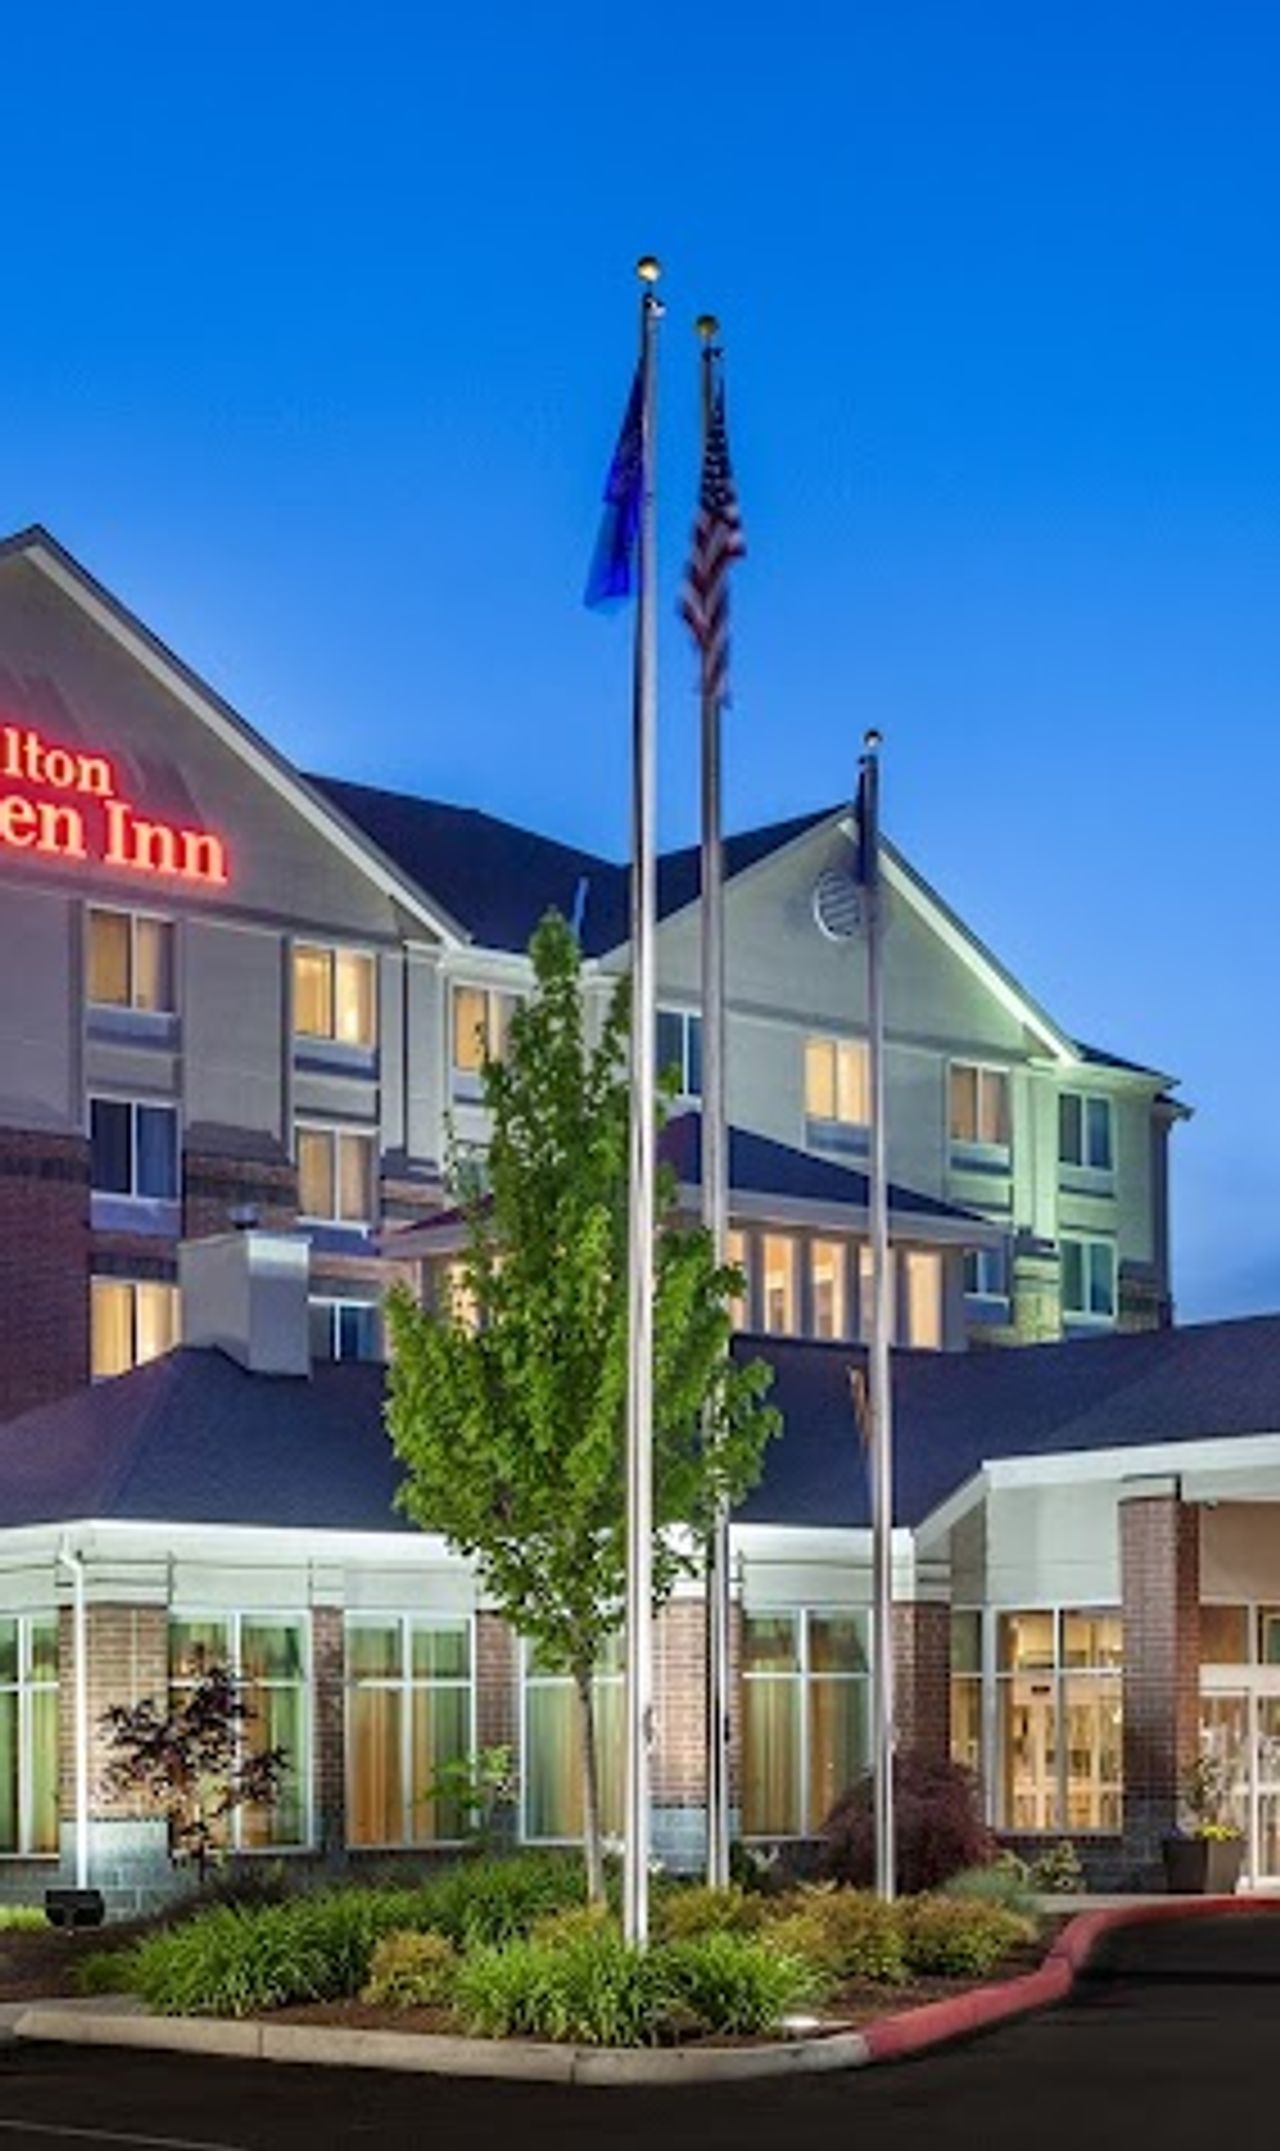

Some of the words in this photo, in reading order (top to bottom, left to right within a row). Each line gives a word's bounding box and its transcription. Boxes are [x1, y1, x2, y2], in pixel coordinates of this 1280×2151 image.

[3, 727, 114, 796] lton
[0, 795, 87, 859] en
[104, 799, 228, 883] Inn
